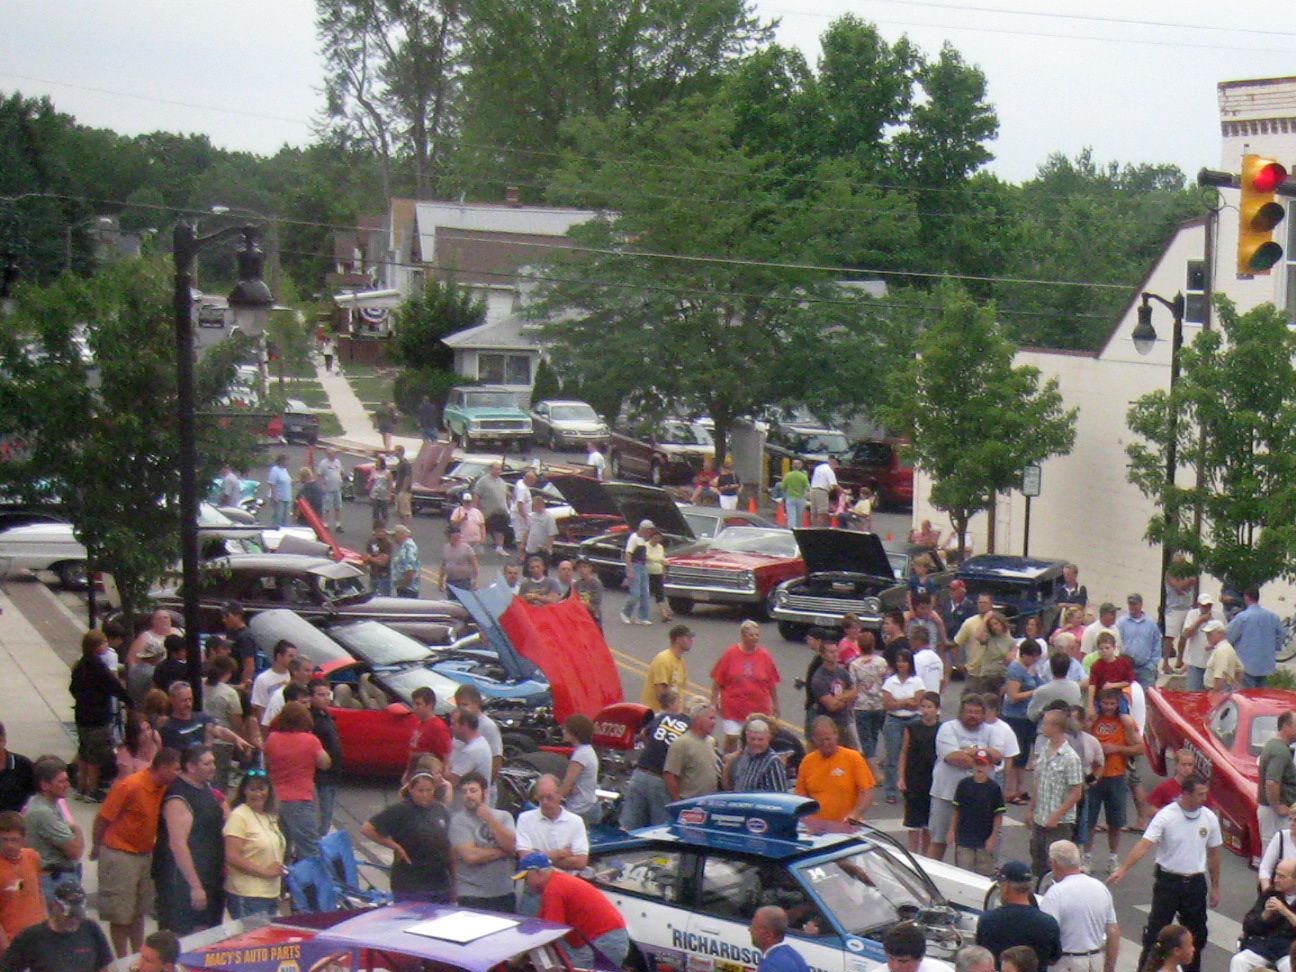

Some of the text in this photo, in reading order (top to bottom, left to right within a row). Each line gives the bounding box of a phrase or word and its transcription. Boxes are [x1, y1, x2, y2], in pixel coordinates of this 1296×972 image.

[661, 715, 688, 732] NS
[653, 727, 677, 745] 83
[205, 945, 302, 967] MACY'S AUTO PARTS
[672, 929, 761, 966] RICHARDSO
